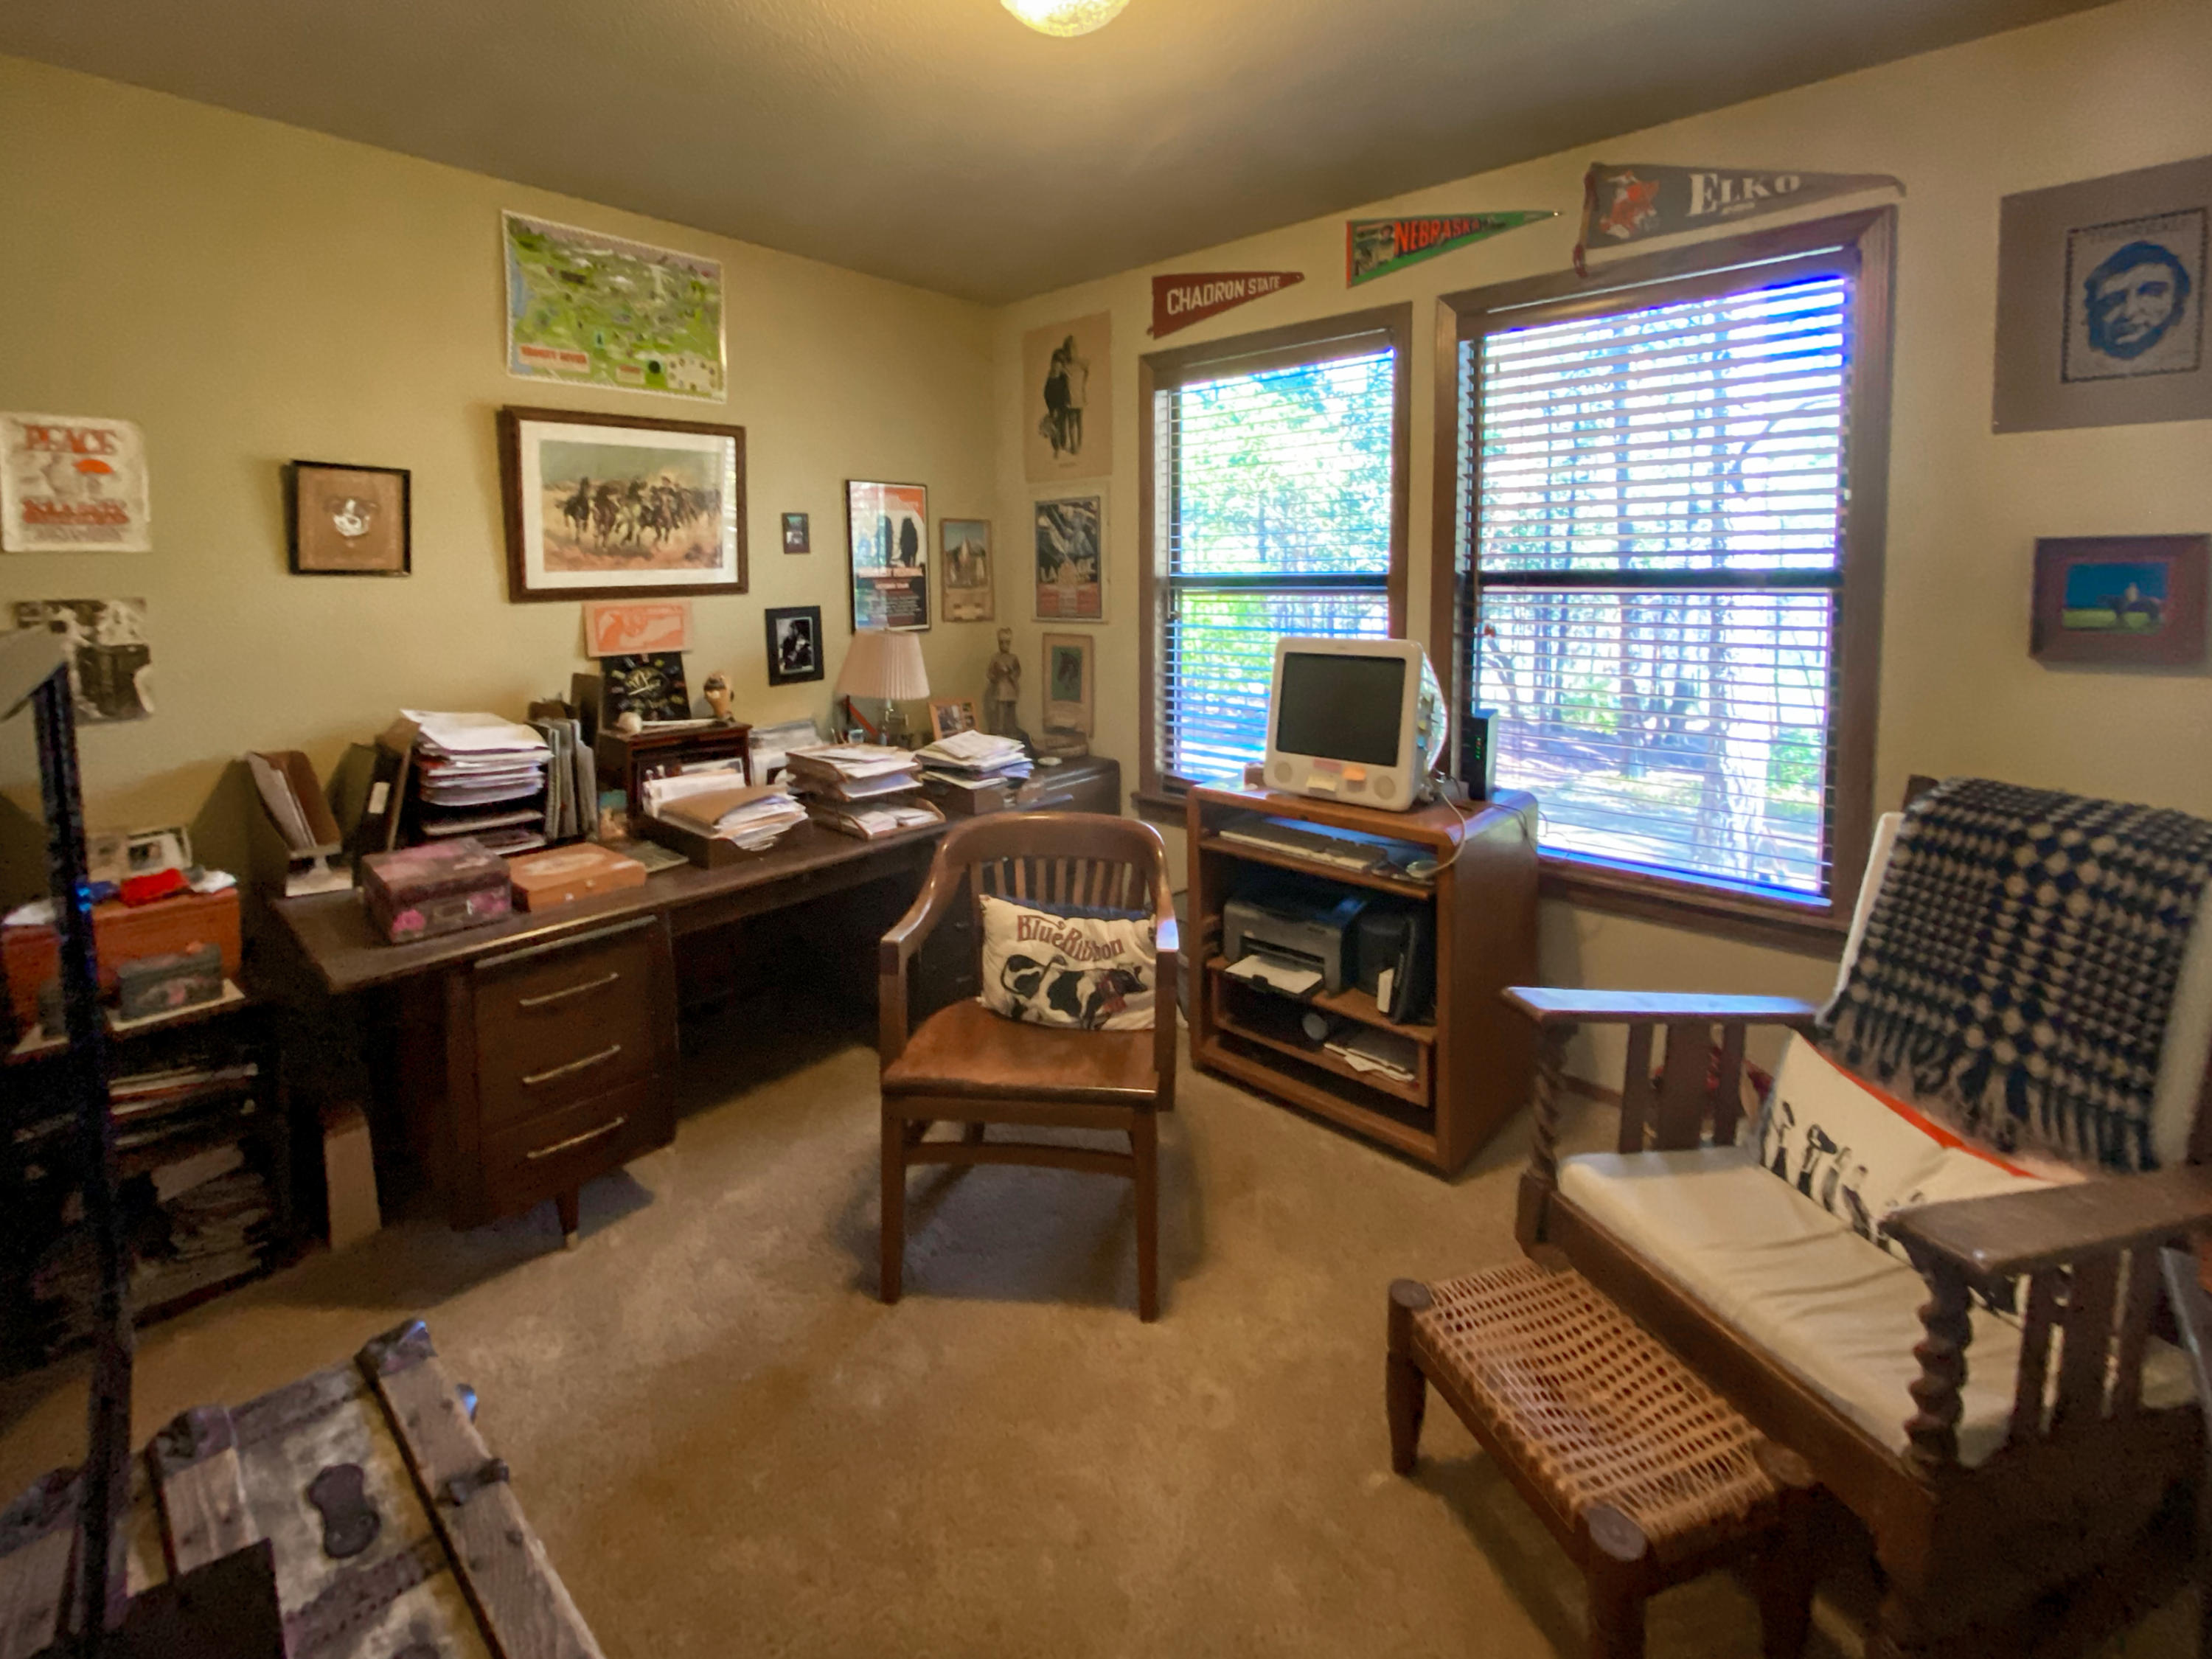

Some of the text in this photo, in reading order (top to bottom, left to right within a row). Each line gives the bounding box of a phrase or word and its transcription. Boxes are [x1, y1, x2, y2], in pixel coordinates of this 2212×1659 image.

[1686, 172, 1801, 217] ELKO
[1167, 276, 1281, 316] CHADRON STATE
[1017, 915, 1125, 961] Blue Ribbon
